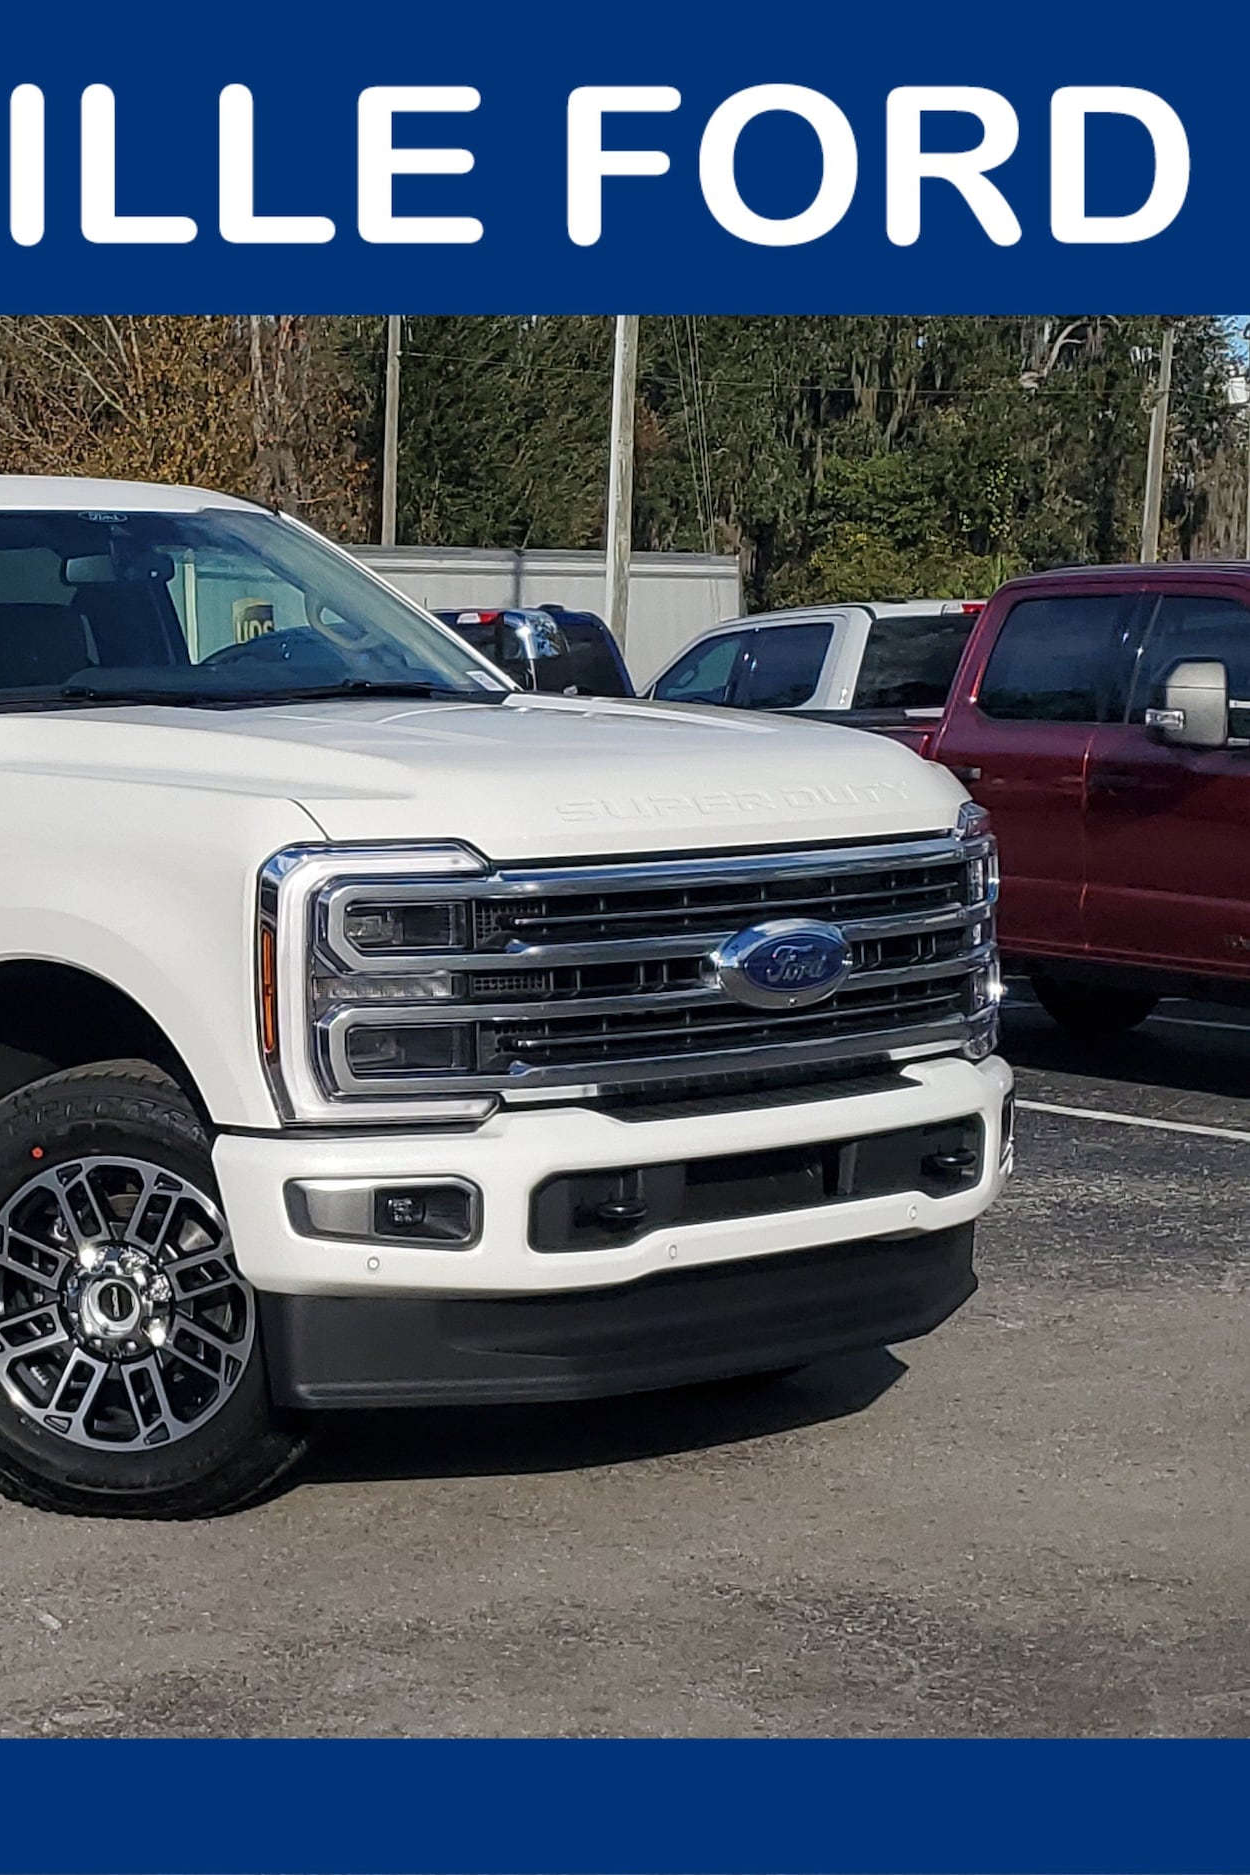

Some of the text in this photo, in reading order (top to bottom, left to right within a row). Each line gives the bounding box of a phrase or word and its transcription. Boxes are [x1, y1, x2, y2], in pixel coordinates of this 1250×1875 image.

[556, 780, 908, 823] SUPER DUTY
[766, 943, 829, 982] Ford
